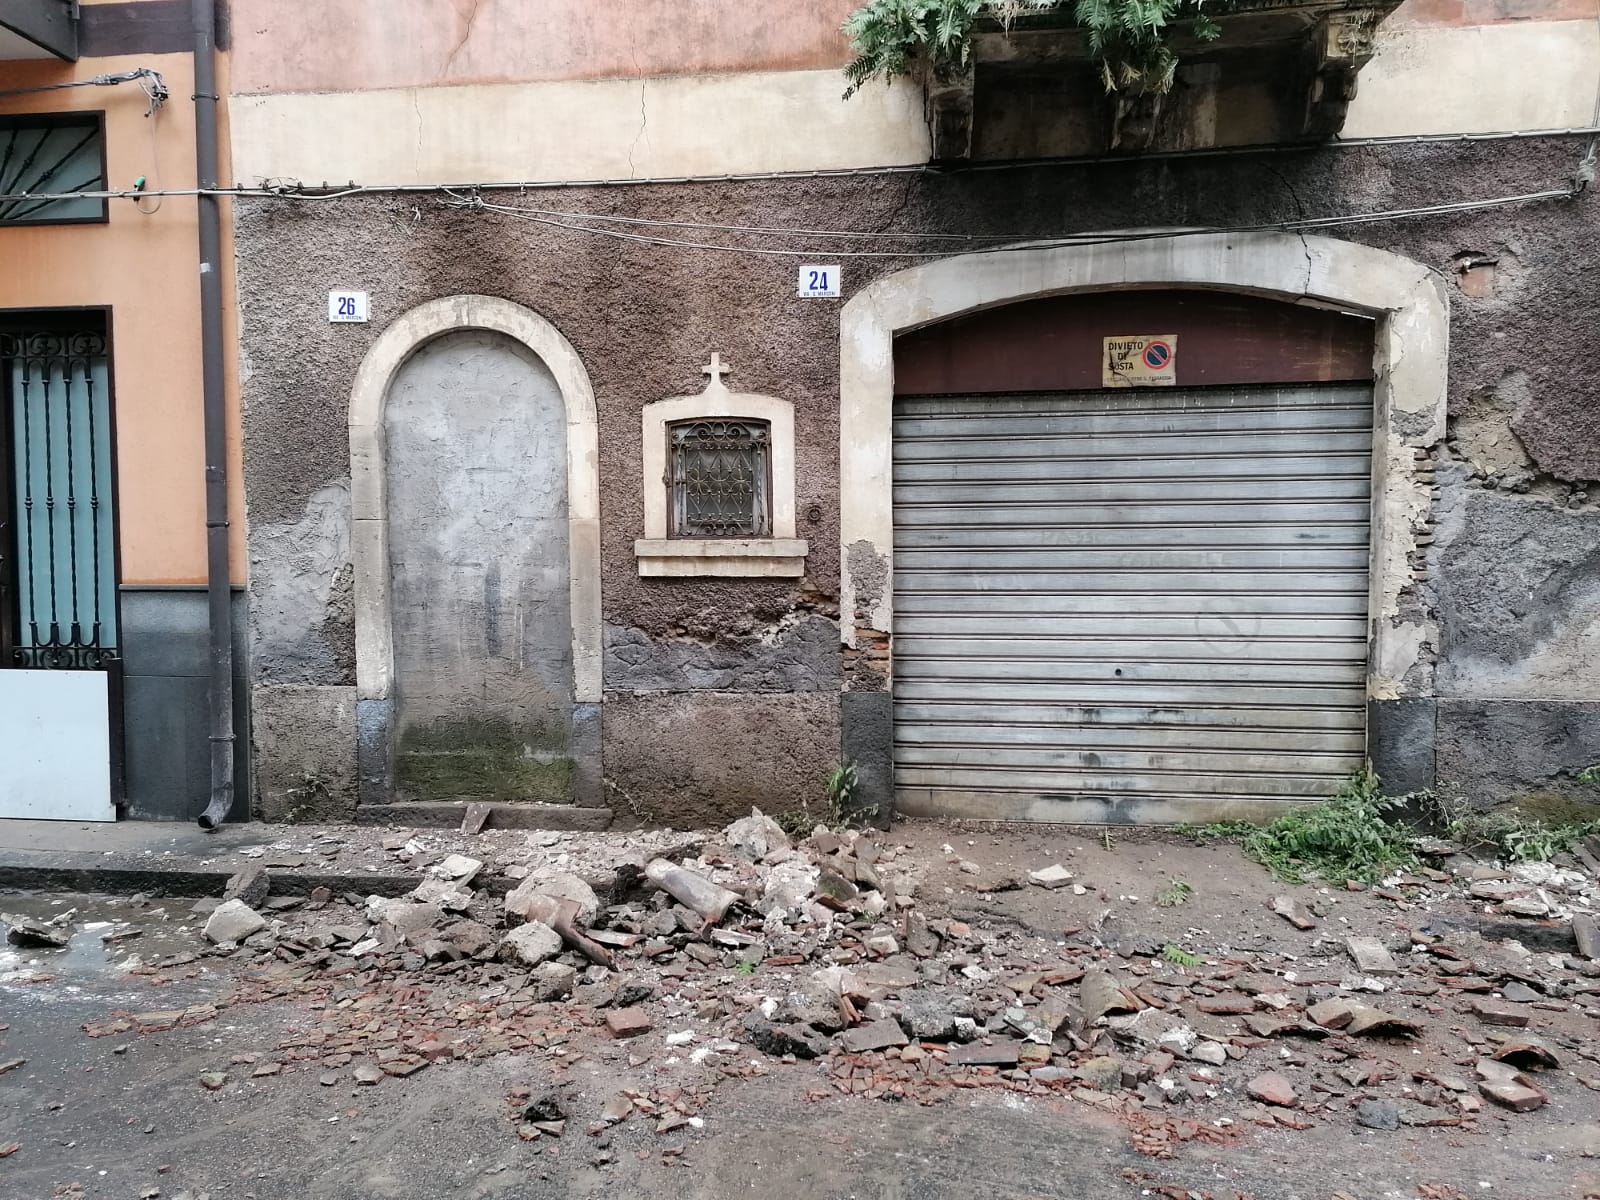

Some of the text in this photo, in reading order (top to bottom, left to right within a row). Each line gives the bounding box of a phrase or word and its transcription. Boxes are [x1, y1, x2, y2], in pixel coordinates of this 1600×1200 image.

[809, 271, 828, 290] 24
[338, 296, 355, 315] 26
[1108, 341, 1143, 350] DIVIETO
[1117, 352, 1127, 360] DI
[1108, 362, 1134, 370] SOSTA
